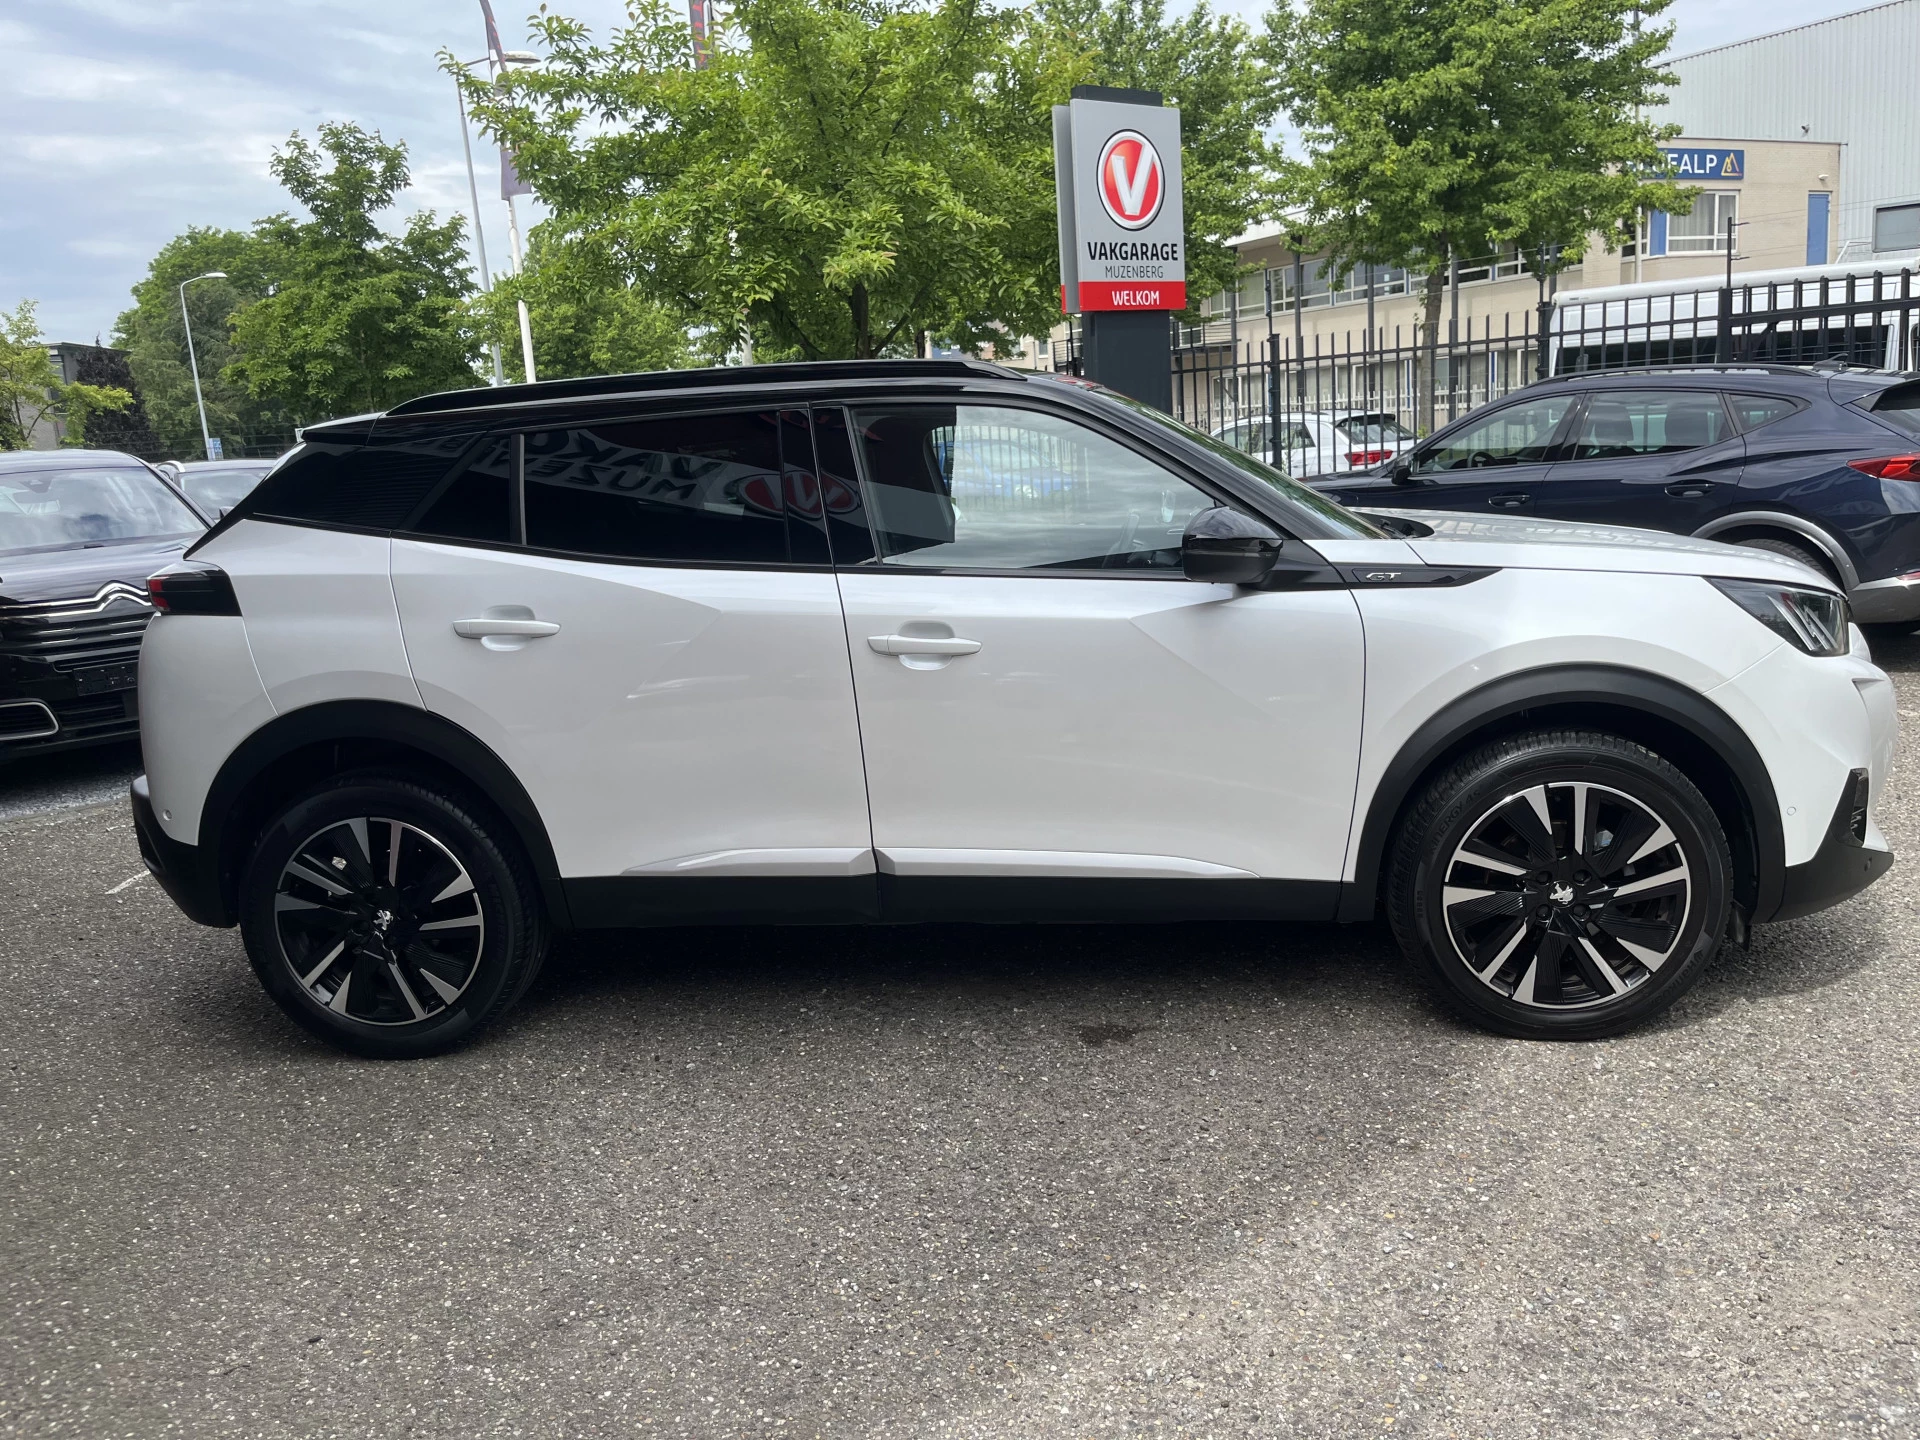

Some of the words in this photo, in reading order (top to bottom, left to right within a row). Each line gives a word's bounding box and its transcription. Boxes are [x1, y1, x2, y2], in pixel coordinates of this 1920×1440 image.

[1087, 241, 1179, 262] VAKGARAGE
[1105, 265, 1164, 279] MUZENBERG
[1112, 290, 1160, 305] WELKOM
[1366, 572, 1402, 581] GT
